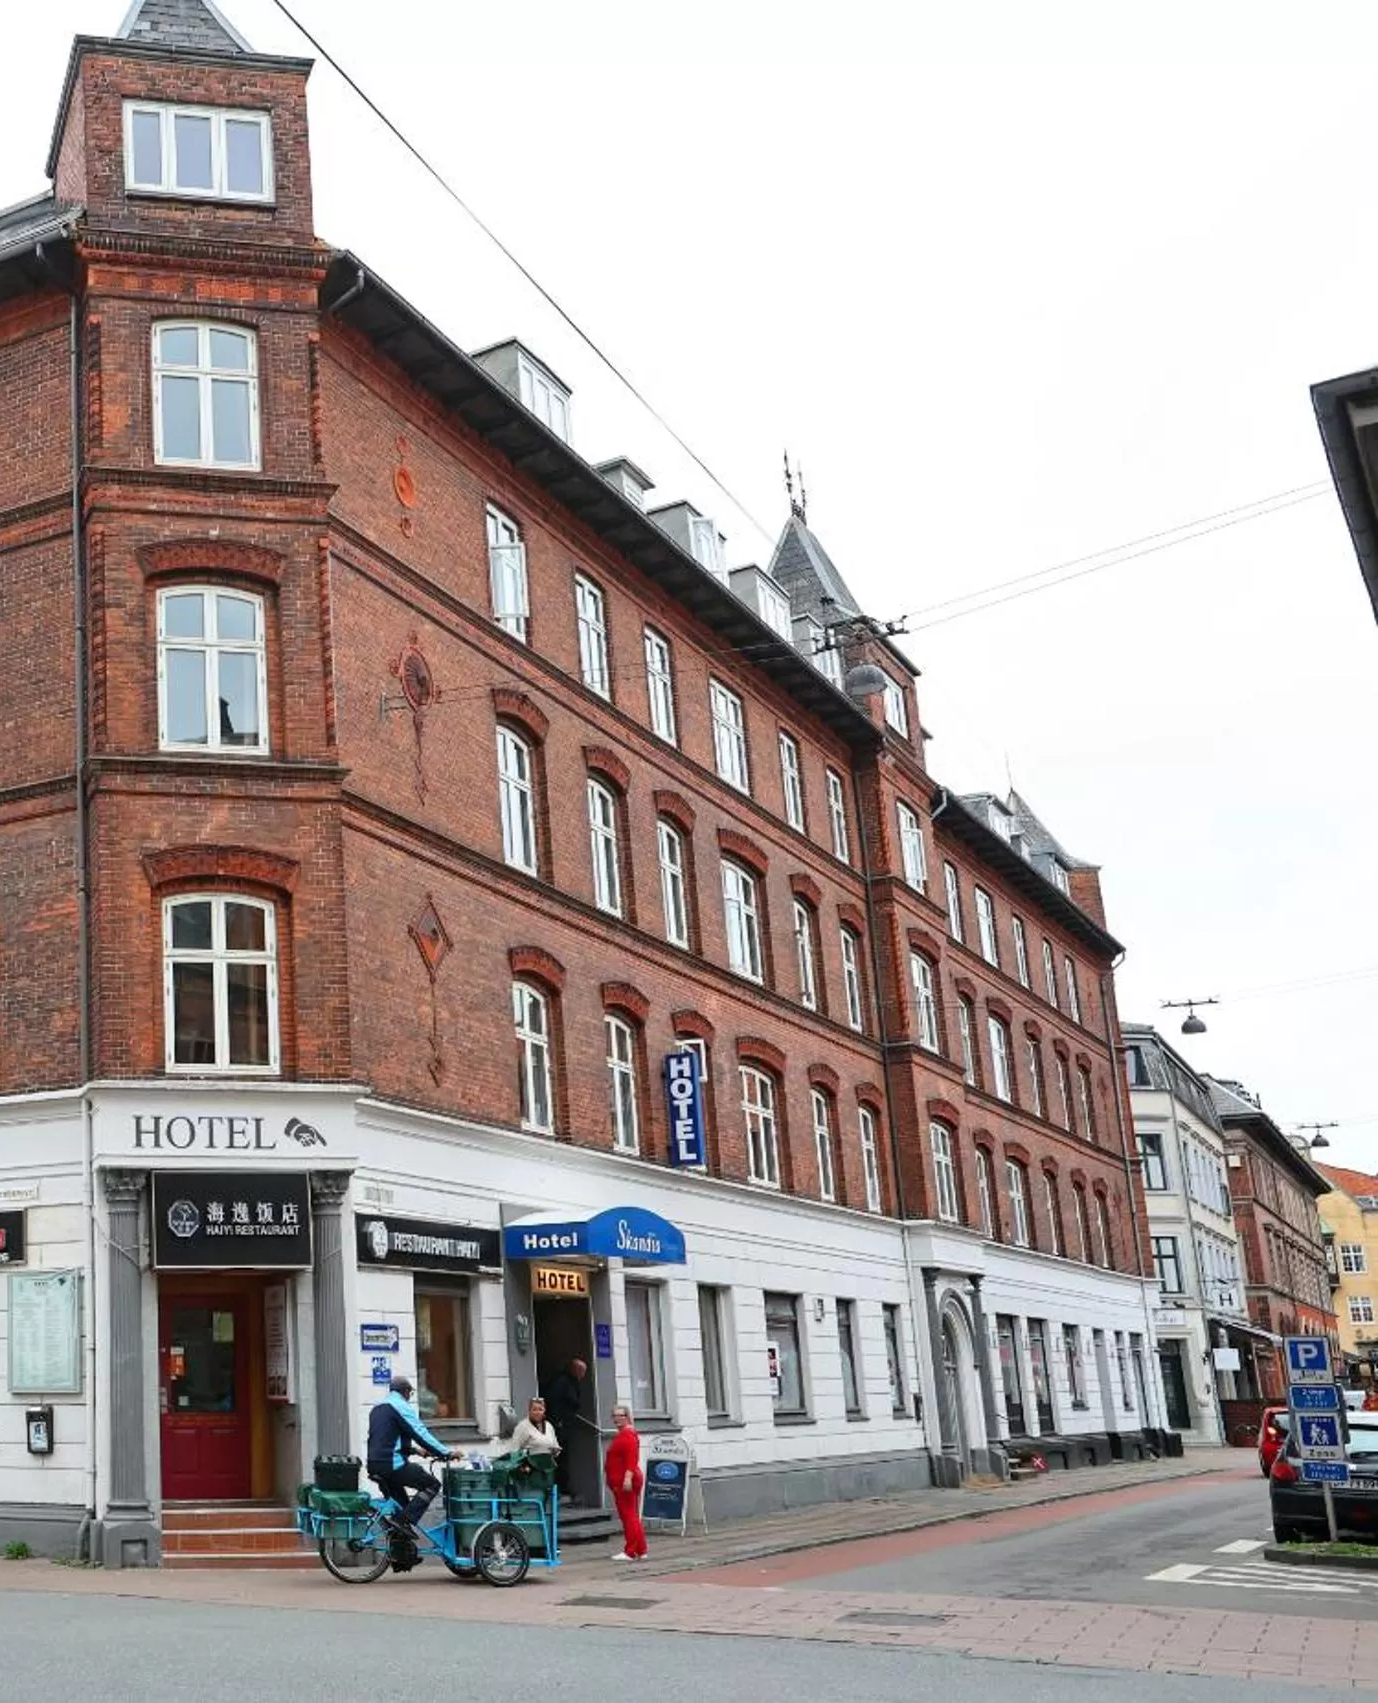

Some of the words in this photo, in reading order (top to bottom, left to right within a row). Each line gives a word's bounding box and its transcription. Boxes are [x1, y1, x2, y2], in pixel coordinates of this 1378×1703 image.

[669, 1057, 698, 1161] HOTEL
[132, 1115, 277, 1150] HOTEL
[206, 1225, 234, 1236] HAIYI
[235, 1225, 301, 1236] RESTAURANT
[524, 1232, 579, 1250] Hotel
[537, 1271, 586, 1293] HOTEL
[1297, 1342, 1318, 1368] P
